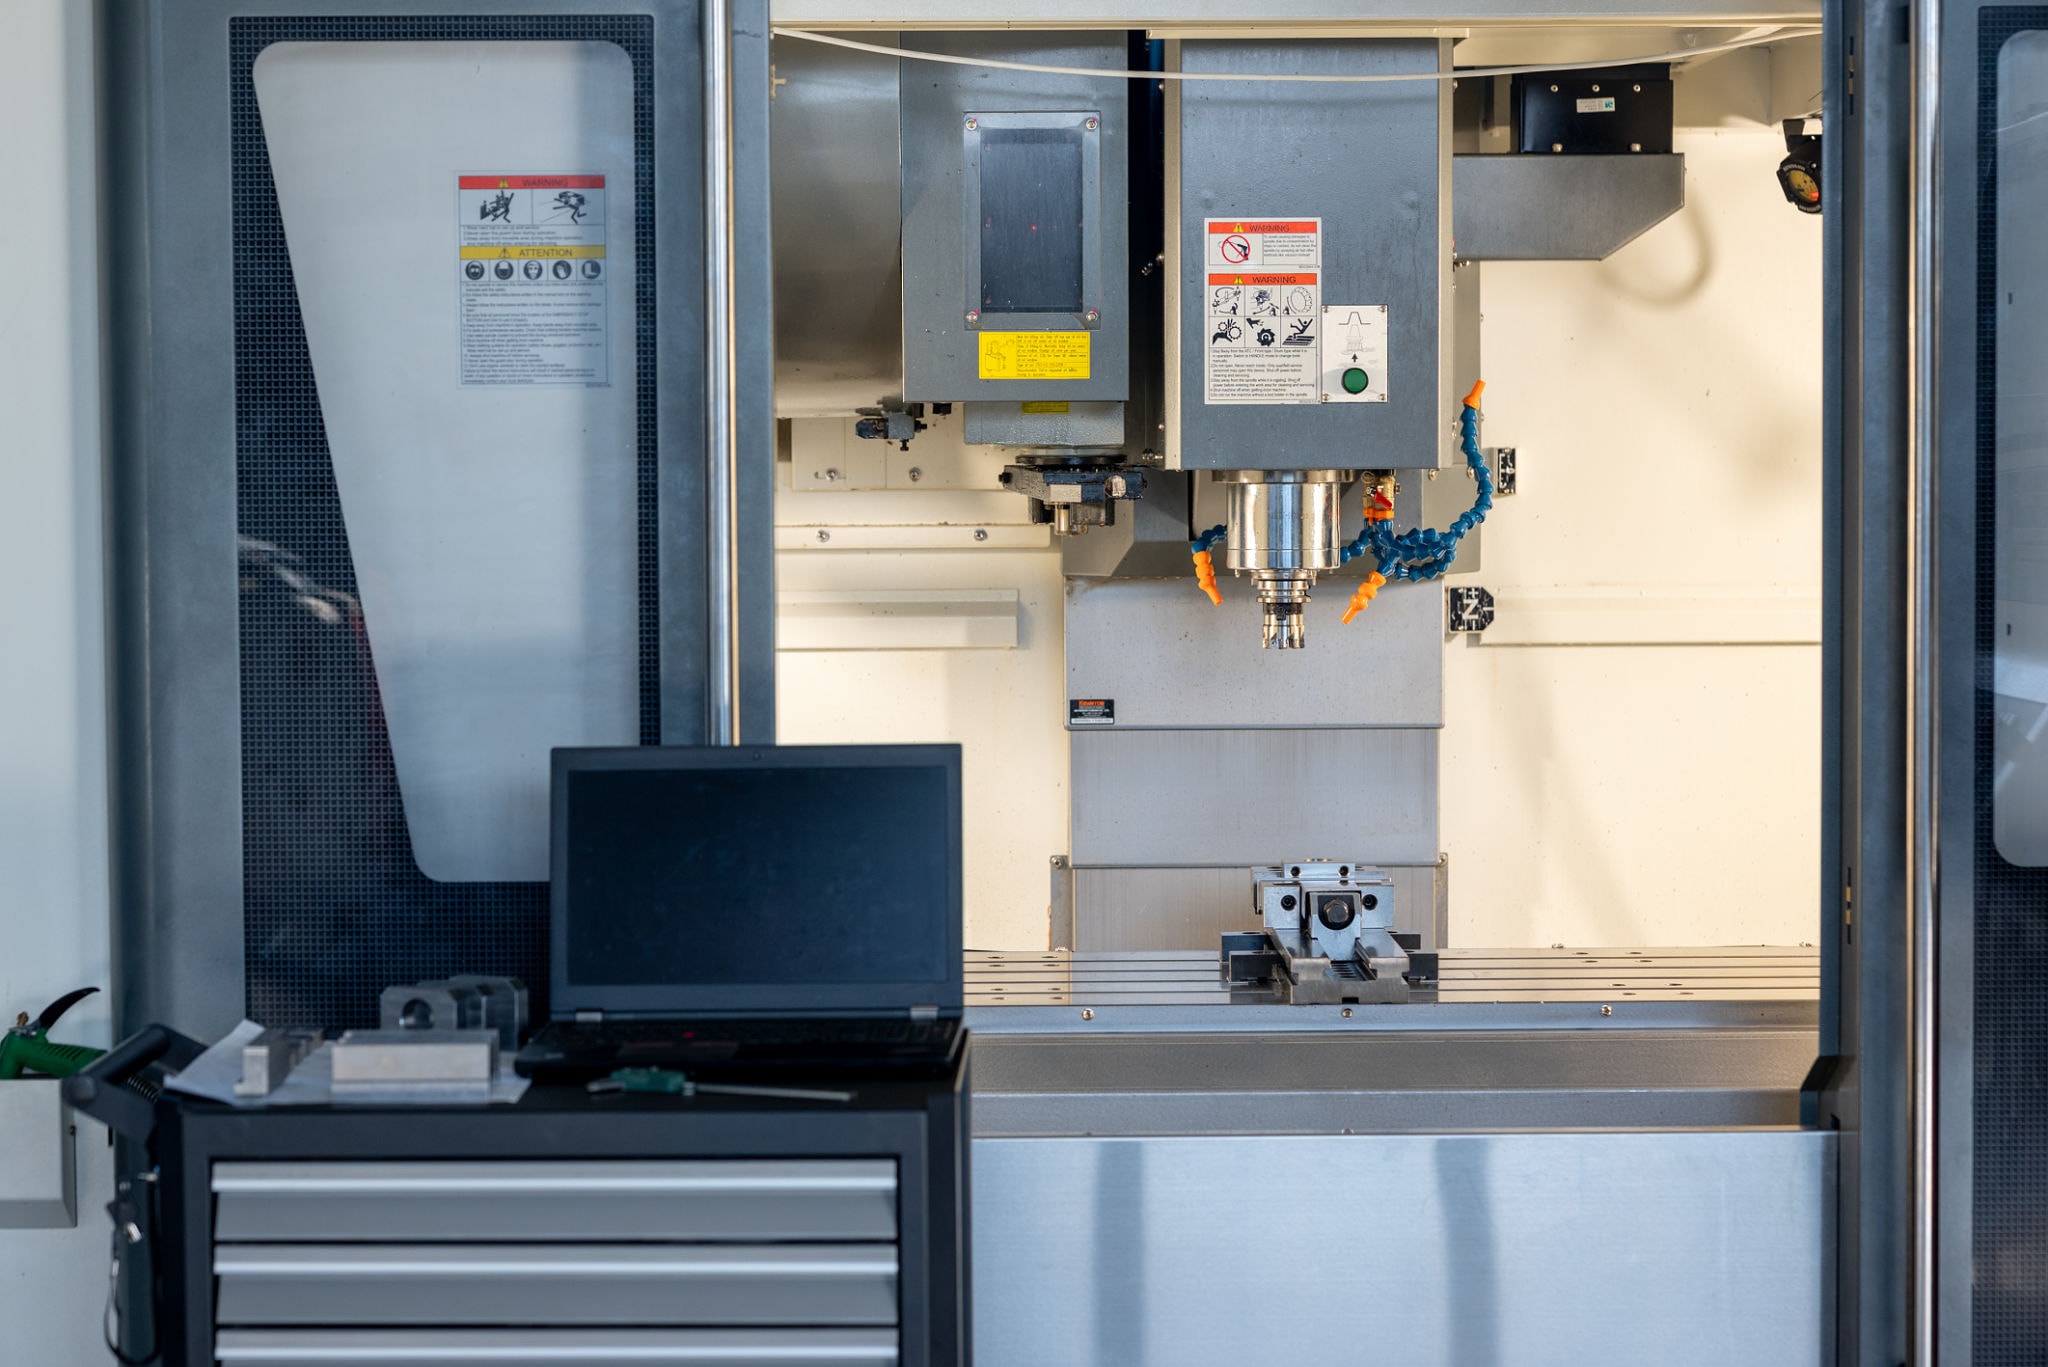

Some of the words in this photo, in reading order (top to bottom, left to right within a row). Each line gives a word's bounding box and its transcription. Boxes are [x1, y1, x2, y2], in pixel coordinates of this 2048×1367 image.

[522, 178, 568, 187] WARNING
[1250, 224, 1290, 232] WARNING
[519, 249, 573, 257] ATTENTION
